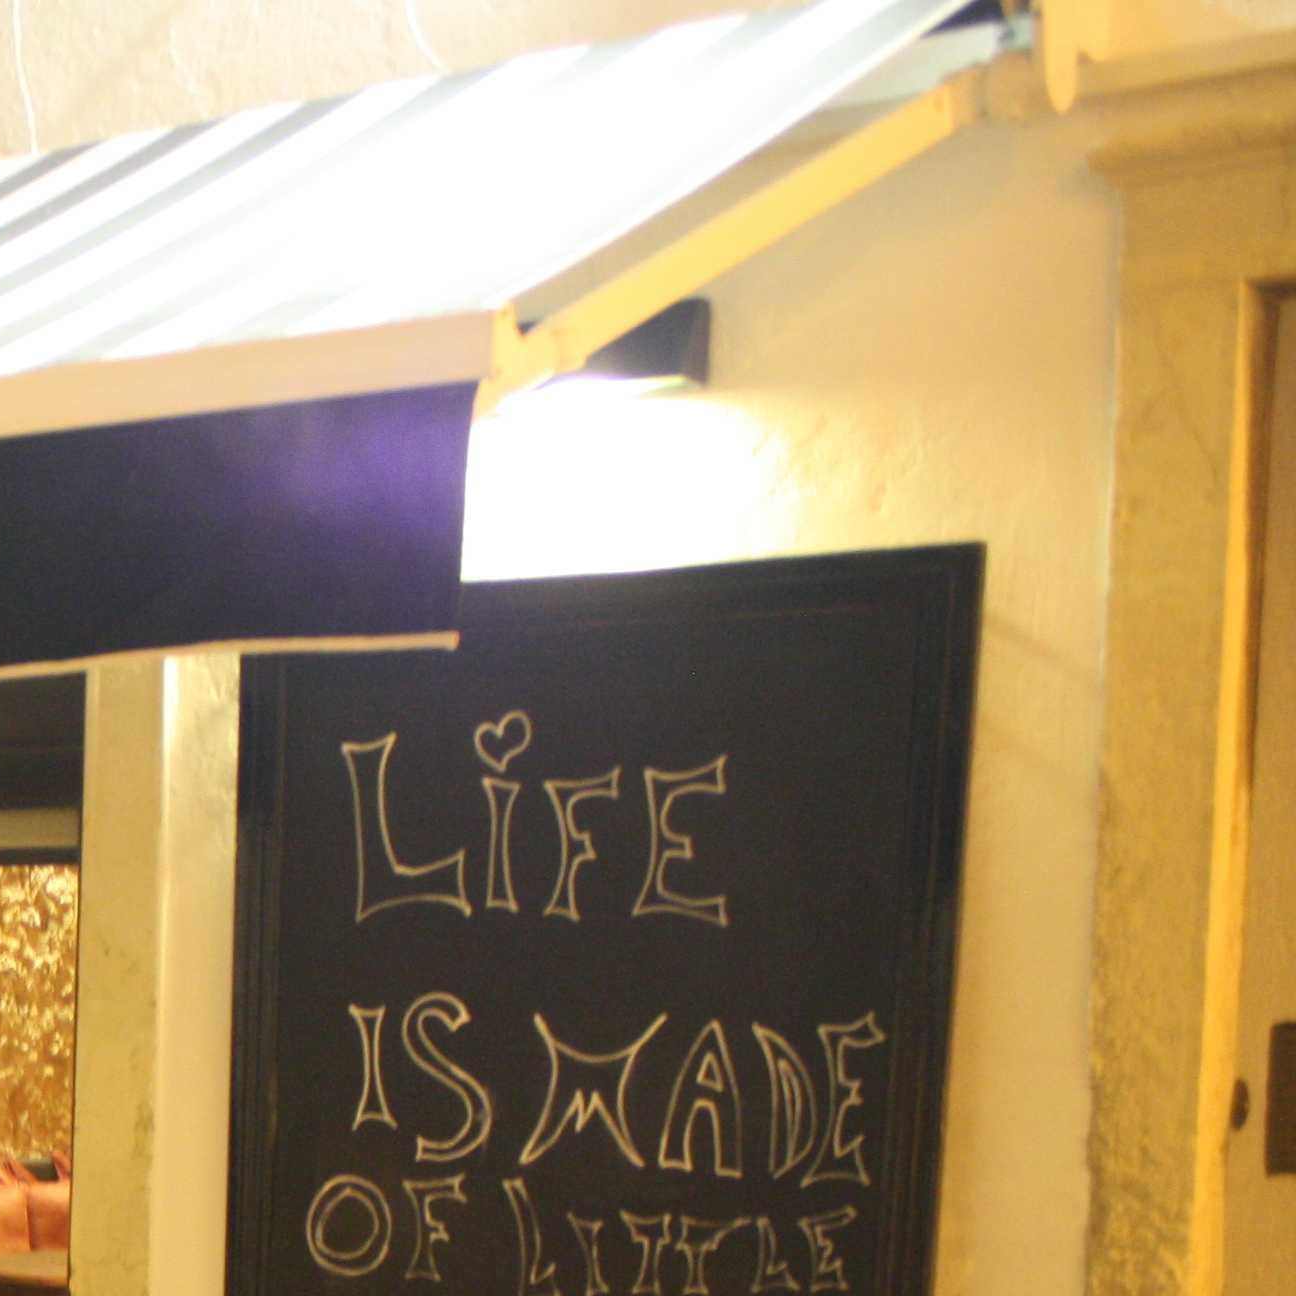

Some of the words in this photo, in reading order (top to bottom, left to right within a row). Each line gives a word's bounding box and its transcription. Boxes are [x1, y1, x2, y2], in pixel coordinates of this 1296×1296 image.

[348, 992, 494, 1162] IS
[518, 1010, 885, 1188] MADE
[305, 1173, 466, 1278] OF
